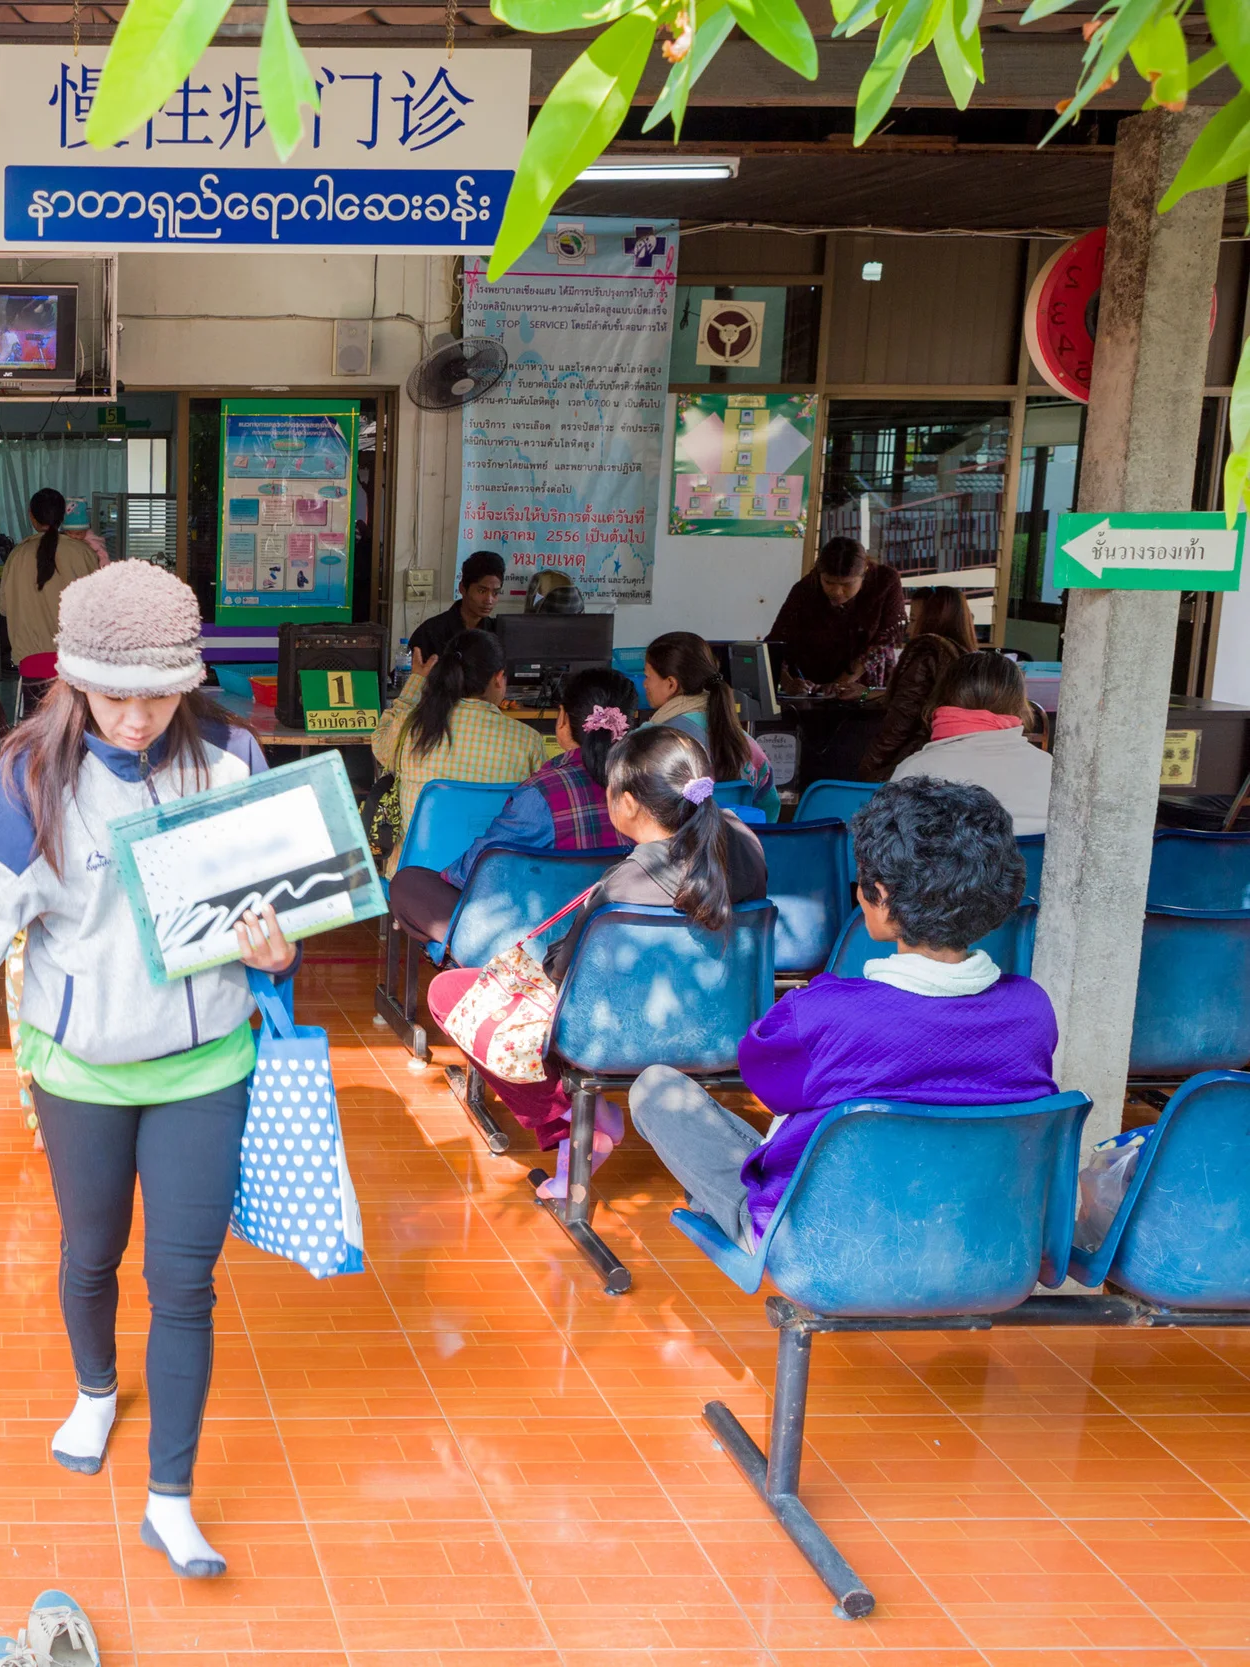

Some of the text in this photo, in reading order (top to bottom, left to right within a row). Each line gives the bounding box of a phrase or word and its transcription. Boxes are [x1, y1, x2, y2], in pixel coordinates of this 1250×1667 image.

[27, 172, 491, 240] နာတာရှည်ရောဂါဆေးခန်း
[496, 320, 521, 329] STOP
[530, 320, 568, 331] SERVICE)
[107, 408, 116, 423] 5
[463, 528, 646, 545] 18 มกราคม 2556 เป็นต้นไป
[1091, 531, 1205, 561] ชั้นวางรองเท้า
[512, 552, 587, 574] หมายเหตุ
[332, 675, 350, 705] 1
[308, 710, 377, 729] รับบัตรคิว
